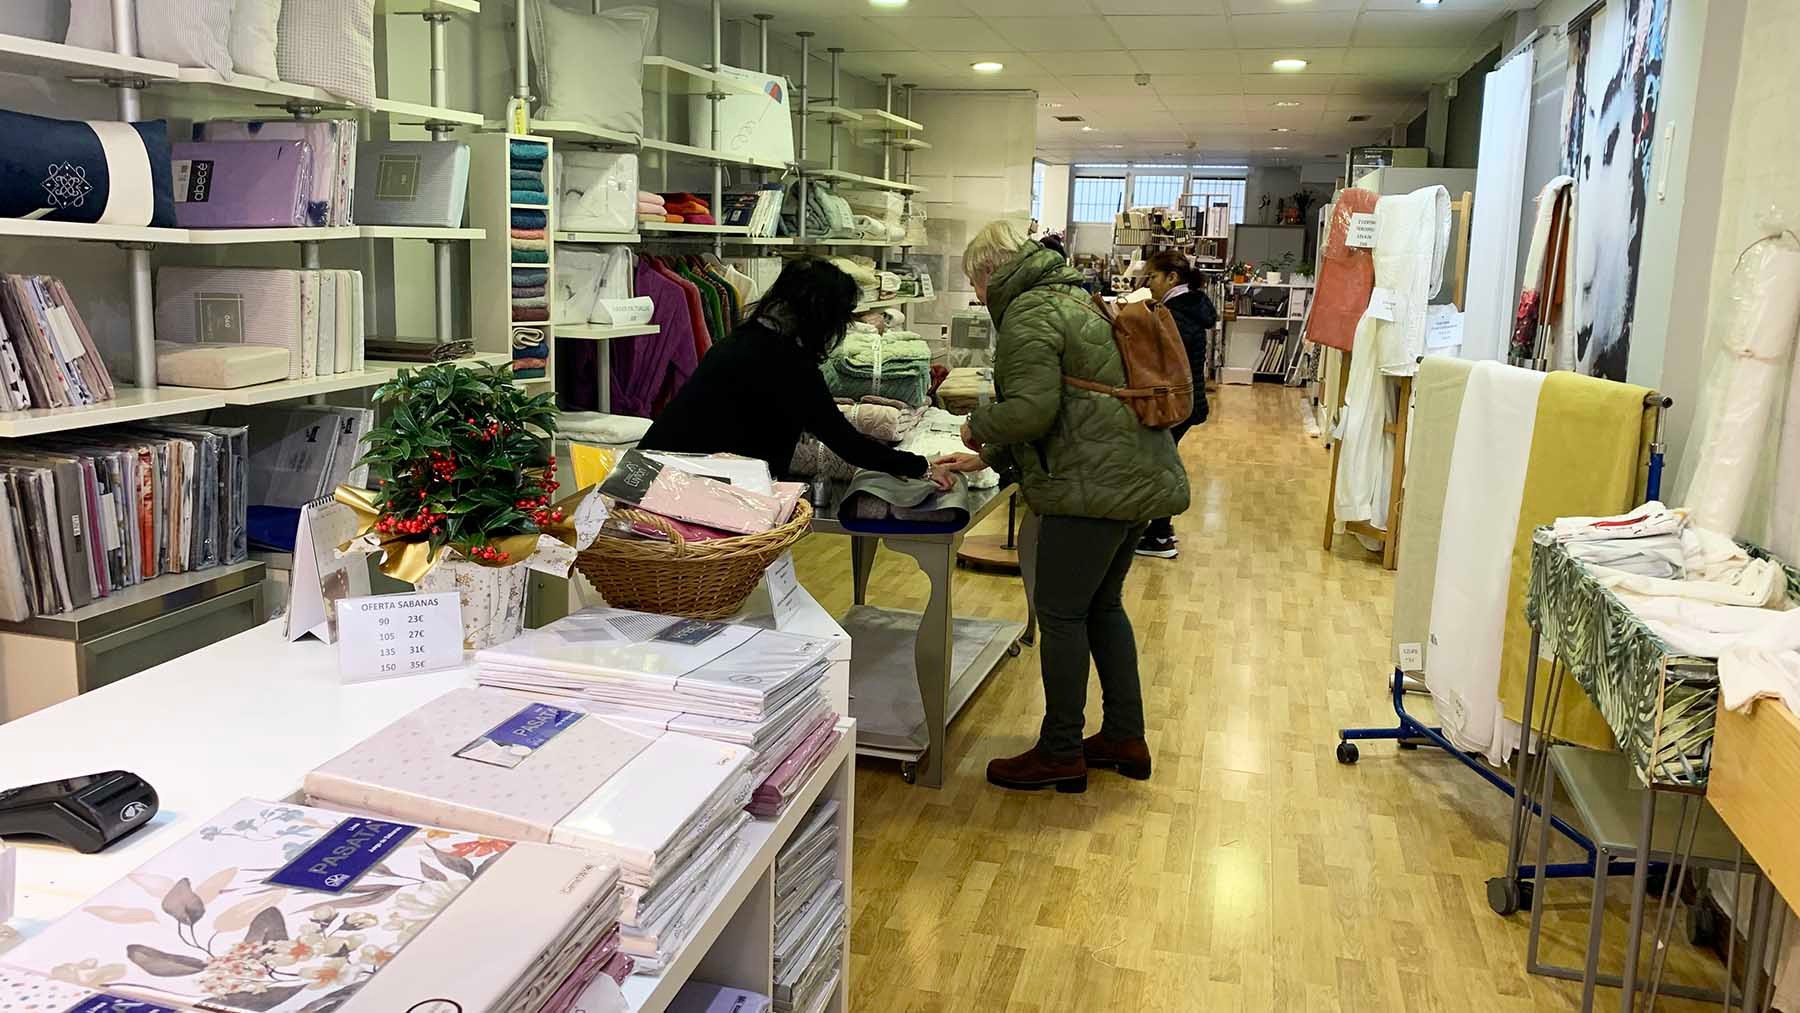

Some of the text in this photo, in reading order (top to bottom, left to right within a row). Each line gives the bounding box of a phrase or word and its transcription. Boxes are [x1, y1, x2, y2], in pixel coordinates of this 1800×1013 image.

[193, 162, 208, 201] abecé
[361, 598, 439, 612] OFERTA SABANAS
[378, 614, 424, 626] 90 23€
[379, 630, 425, 641] 105 27€
[379, 645, 425, 657] 135 31€
[380, 660, 425, 672] 150 35€
[512, 706, 559, 737] PASATA
[308, 822, 390, 875] PASATA
